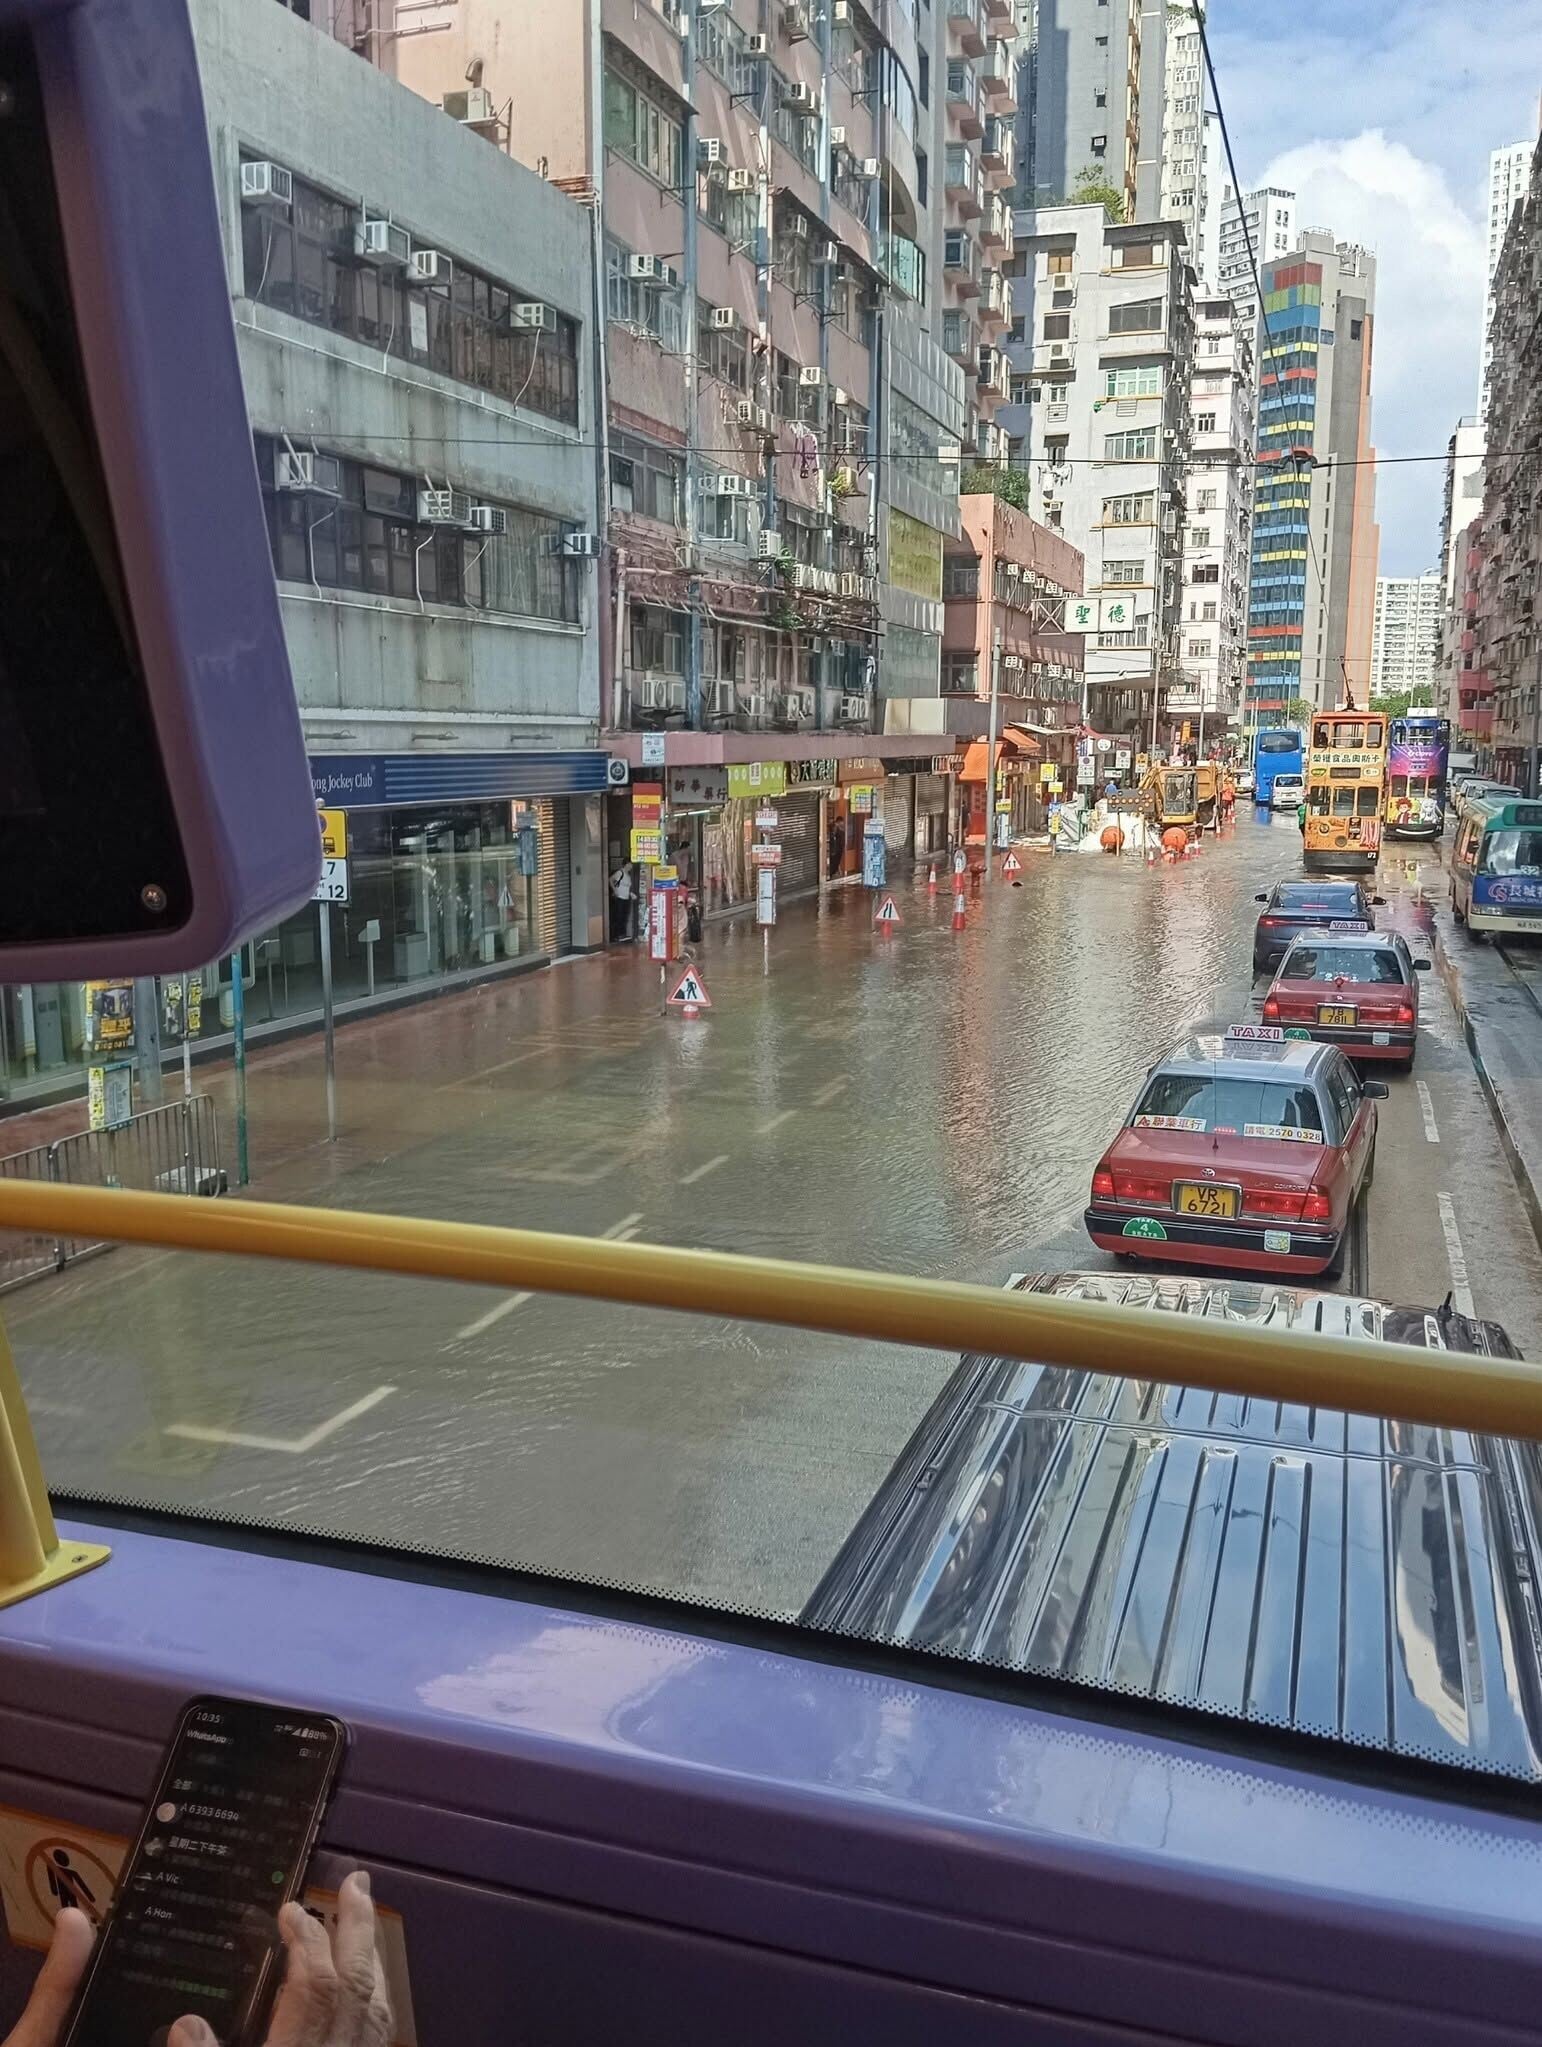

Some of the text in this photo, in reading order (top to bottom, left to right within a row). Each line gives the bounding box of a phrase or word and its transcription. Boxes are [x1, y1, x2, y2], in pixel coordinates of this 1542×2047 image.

[312, 773, 373, 793] ong Jockey Club
[326, 861, 336, 876] 7
[328, 884, 345, 899] 12
[1332, 921, 1365, 930] TAXI
[1328, 1015, 1347, 1025] 7811
[1231, 1026, 1280, 1040] TAXI
[1269, 1127, 1293, 1137] 2570
[1296, 1130, 1322, 1141] 0328
[1197, 1187, 1219, 1201] VR
[1187, 1200, 1226, 1216] 6721
[1140, 1223, 1149, 1232] 4
